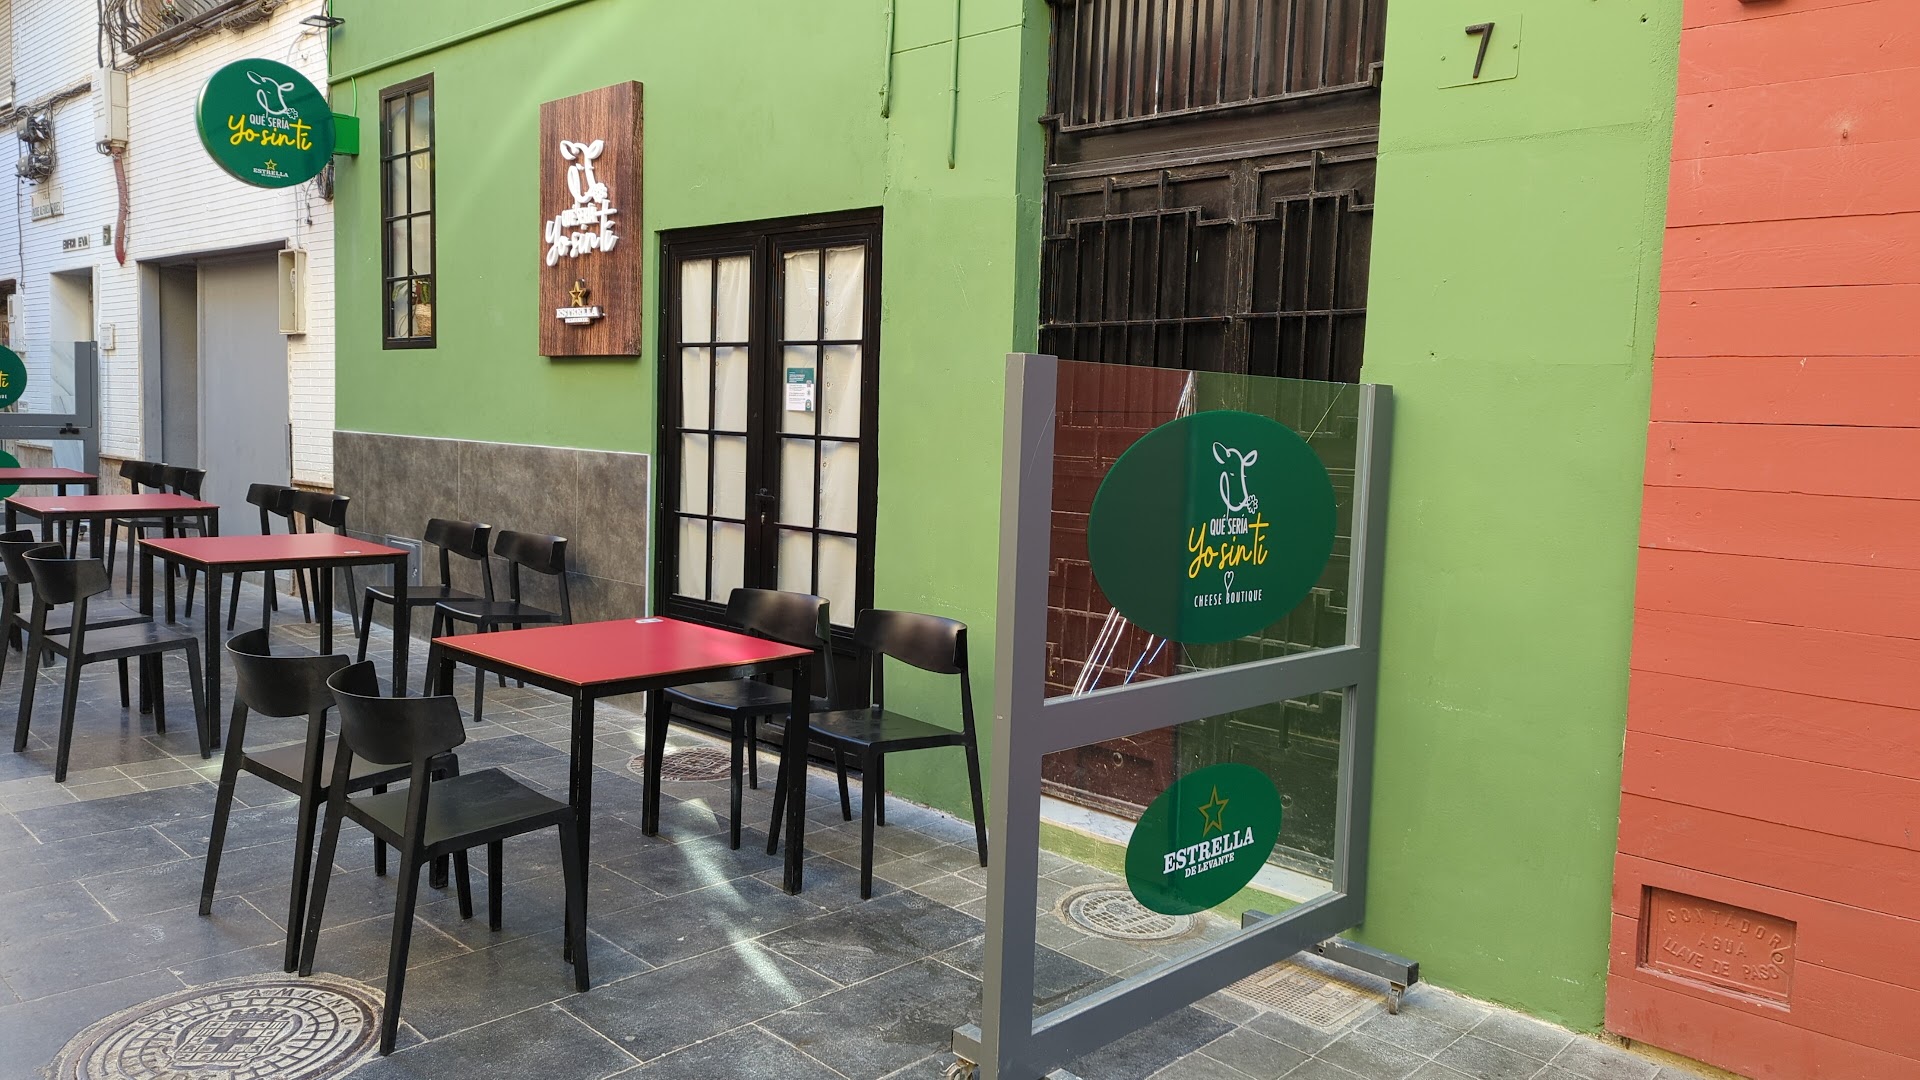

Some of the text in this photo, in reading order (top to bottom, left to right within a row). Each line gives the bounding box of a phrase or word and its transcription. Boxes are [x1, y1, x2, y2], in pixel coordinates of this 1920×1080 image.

[1465, 22, 1495, 79] 7
[249, 114, 290, 130] QUÉ SERÍA
[252, 167, 289, 178] ESTRELLA
[1210, 513, 1249, 536] QUÉ SERÍA
[1194, 589, 1262, 607] CHEESE BOUTIQUE
[1162, 826, 1254, 875] ESTRELLA
[1184, 852, 1235, 878] DE LEVANTE
[1665, 907, 1782, 949] CONTADOR
[1697, 932, 1748, 958] AGUA
[1662, 937, 1780, 981] LLAVE DE PASO
[136, 986, 361, 1027] SANEAMIENTO
